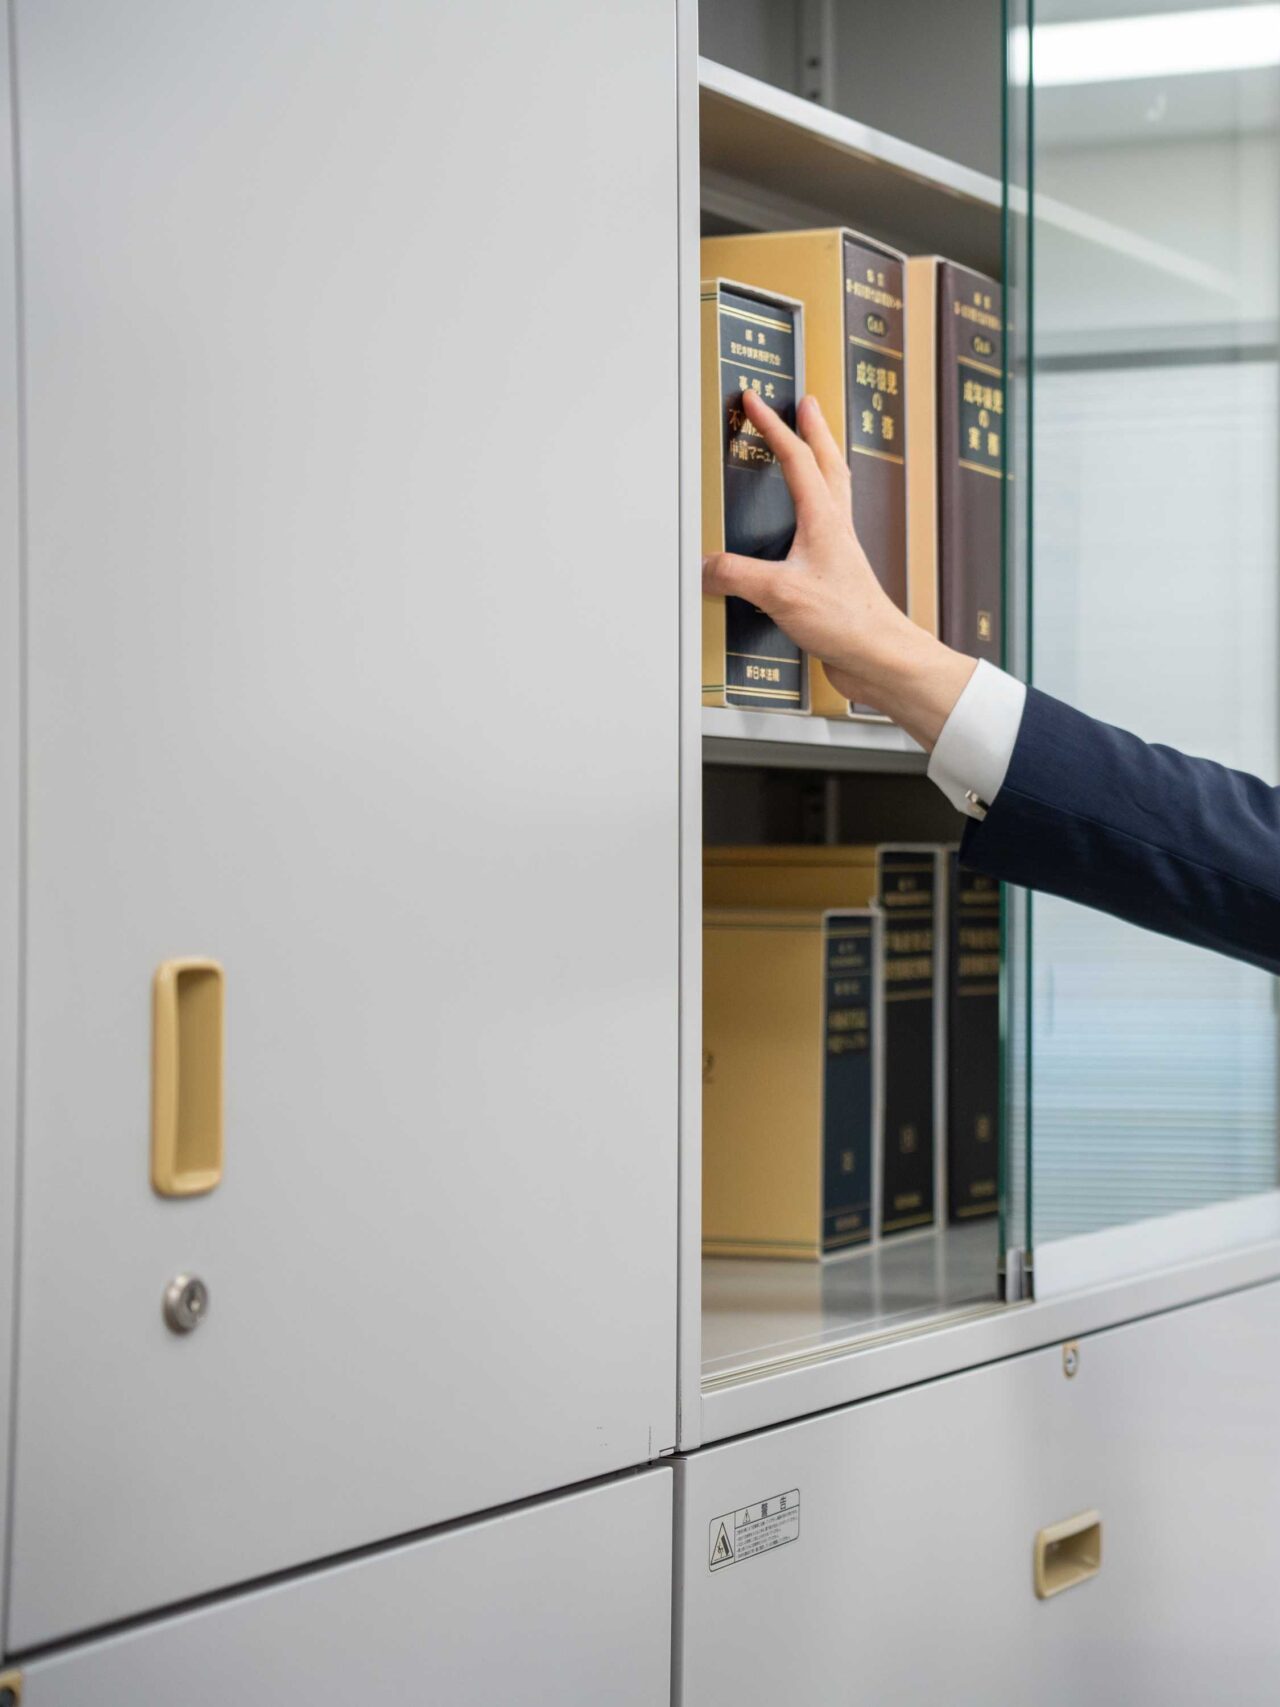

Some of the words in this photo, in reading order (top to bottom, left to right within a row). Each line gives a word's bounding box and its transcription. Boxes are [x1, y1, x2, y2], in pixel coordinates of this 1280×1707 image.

[871, 392, 882, 411] の
[729, 438, 781, 466] 申請マニュ
